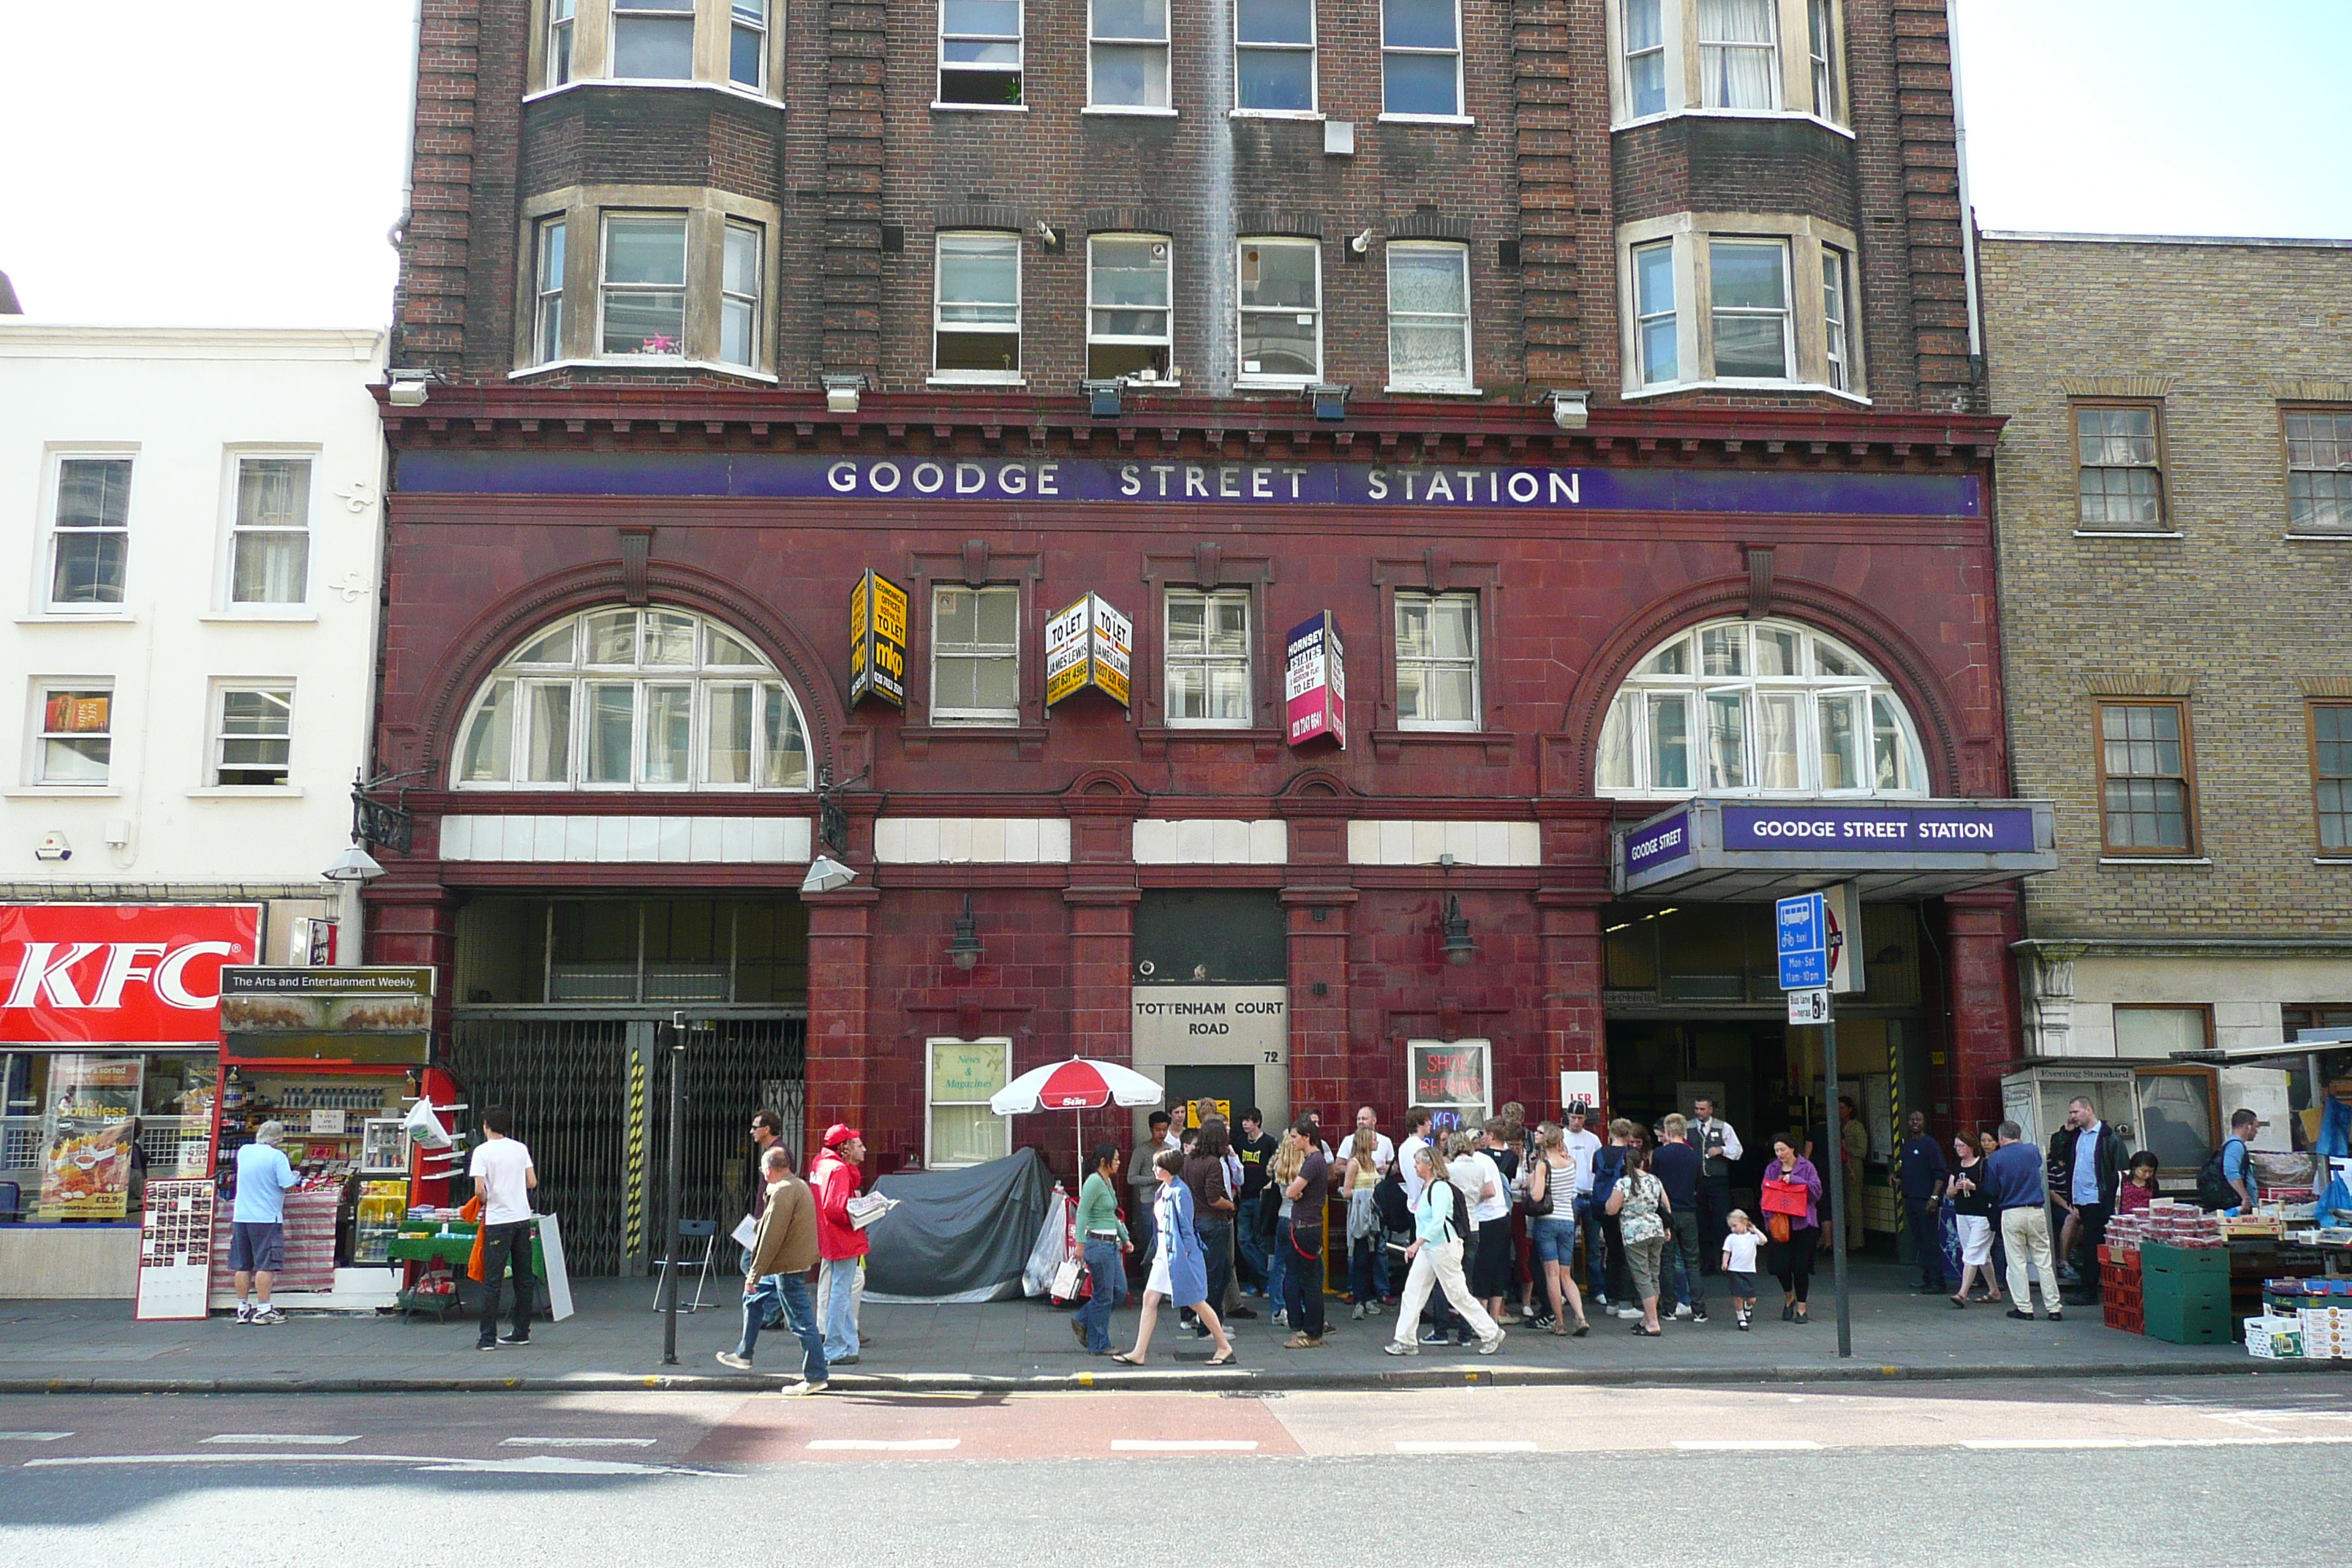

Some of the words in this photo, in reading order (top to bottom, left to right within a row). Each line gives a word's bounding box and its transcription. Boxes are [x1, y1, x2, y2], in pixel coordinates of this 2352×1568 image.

[827, 461, 1059, 495] GOODGE
[1120, 464, 1308, 499] STREET
[1368, 469, 1580, 504] STATION
[881, 595, 901, 614] OFFICES
[878, 614, 889, 633] TO
[891, 620, 903, 641] LET
[1052, 625, 1063, 645] TO
[1066, 611, 1082, 637] LET
[1100, 611, 1111, 633] TO
[1112, 621, 1127, 645] LET
[1288, 627, 1324, 657] HORNSEY
[876, 641, 903, 681] mkp
[1048, 655, 1068, 677] JAMES
[1068, 642, 1088, 664] LEWIS
[1094, 642, 1113, 663] JAMES
[1112, 652, 1129, 677] LEWIS
[1289, 644, 1322, 669] ESTATES
[1293, 682, 1303, 696] TO
[1303, 677, 1315, 692] LET
[78, 702, 88, 728] Subs
[88, 702, 97, 723] KFC
[1753, 821, 1836, 837] GOODGE
[1843, 821, 1909, 838] STREET
[1918, 822, 1994, 838] STATION
[1632, 837, 1659, 861] GOODGE
[1659, 827, 1682, 851] STREET
[1796, 932, 1808, 943] taxi
[1, 941, 233, 1009] KFC
[233, 976, 252, 987] The
[255, 976, 276, 987] Arts
[279, 976, 299, 987] and
[301, 976, 376, 987] Entertainment
[1136, 1002, 1226, 1015] TOTTENHAM
[1235, 1001, 1284, 1014] COURT
[1790, 995, 1799, 1004] Bus
[1801, 995, 1811, 1004] lane
[1188, 1022, 1229, 1035] ROAD
[957, 1055, 981, 1064] News
[1264, 1051, 1278, 1063] 72
[1426, 1053, 1470, 1074] SHOE
[99, 1066, 127, 1074] sorted
[965, 1066, 973, 1077] &
[2040, 1069, 2082, 1079] Evening
[2083, 1069, 2130, 1079] Standard
[945, 1079, 993, 1090] Magazines
[1418, 1076, 1482, 1096] REPAIRS
[1062, 1096, 1087, 1107] Sun
[103, 1114, 126, 1125] box
